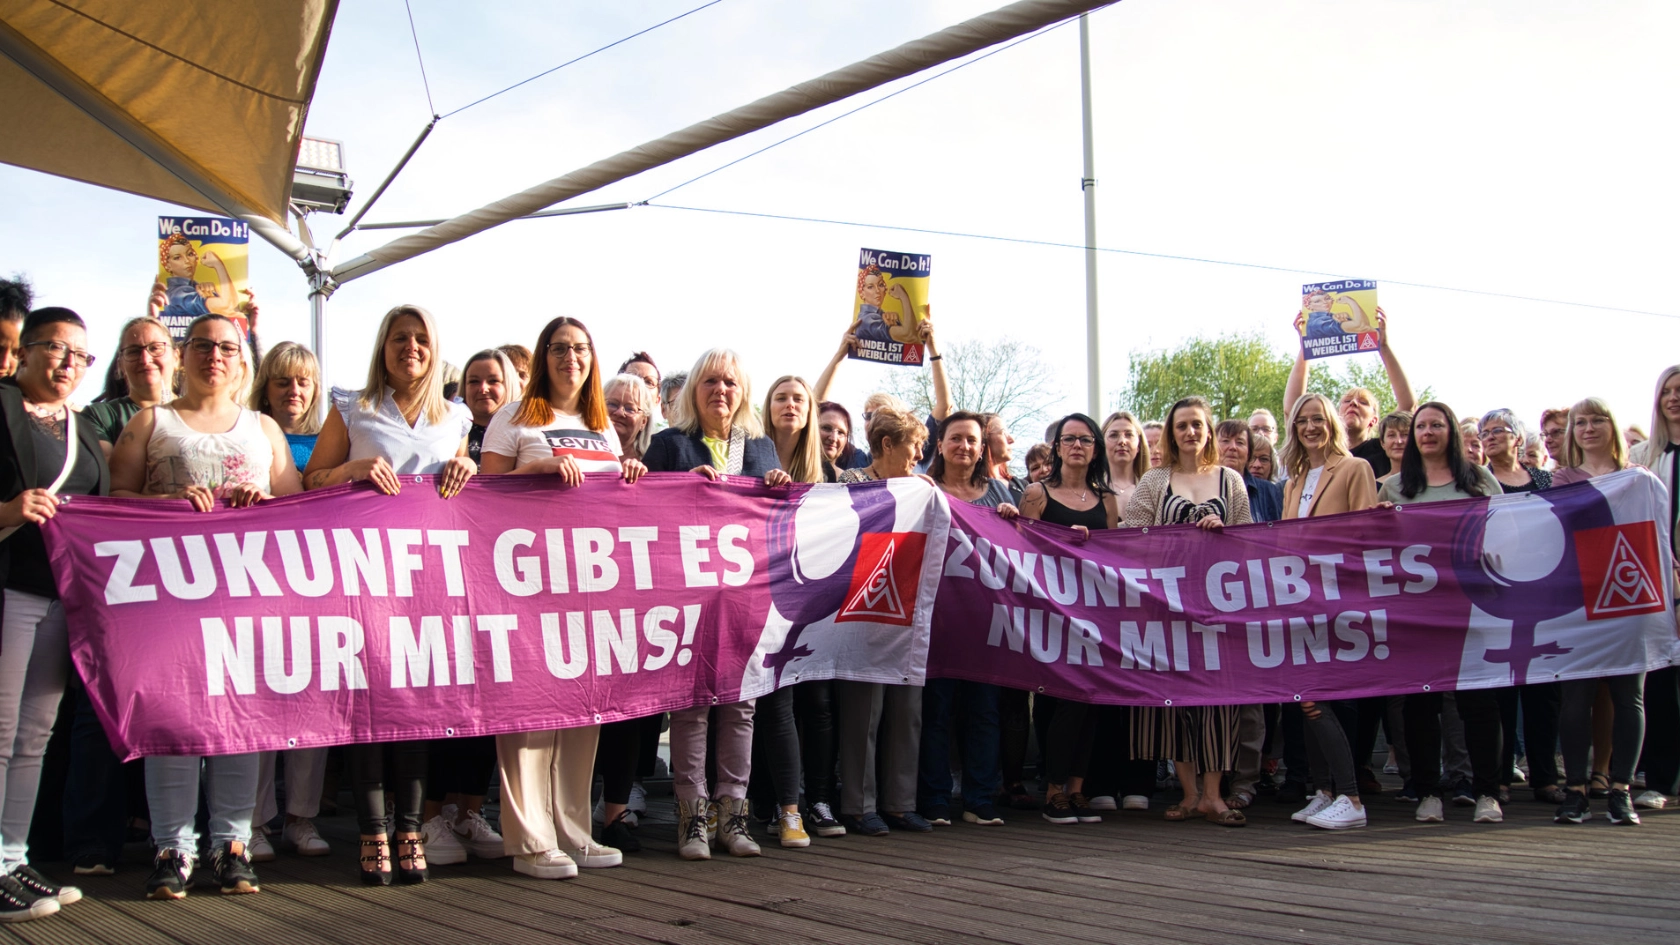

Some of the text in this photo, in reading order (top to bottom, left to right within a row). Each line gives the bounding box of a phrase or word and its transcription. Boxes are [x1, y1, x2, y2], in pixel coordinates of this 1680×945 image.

[159, 218, 248, 238] We Can Do It!
[861, 250, 930, 271] We Can Do It!
[1303, 285, 1320, 293] We
[1345, 281, 1361, 289] Do
[858, 339, 903, 352] ANDEL IST
[1304, 334, 1357, 348] WANDEL IST
[1312, 344, 1357, 356] WEIBLICH!
[857, 348, 902, 362] WEIBLICH!
[93, 524, 755, 606] ZUKUNFT GIBT ES
[944, 527, 1439, 613] ZUKUNFT GIBT ES
[987, 603, 1391, 672] NUR MIT UNS!
[200, 603, 702, 697] NUR MIT UNS!
